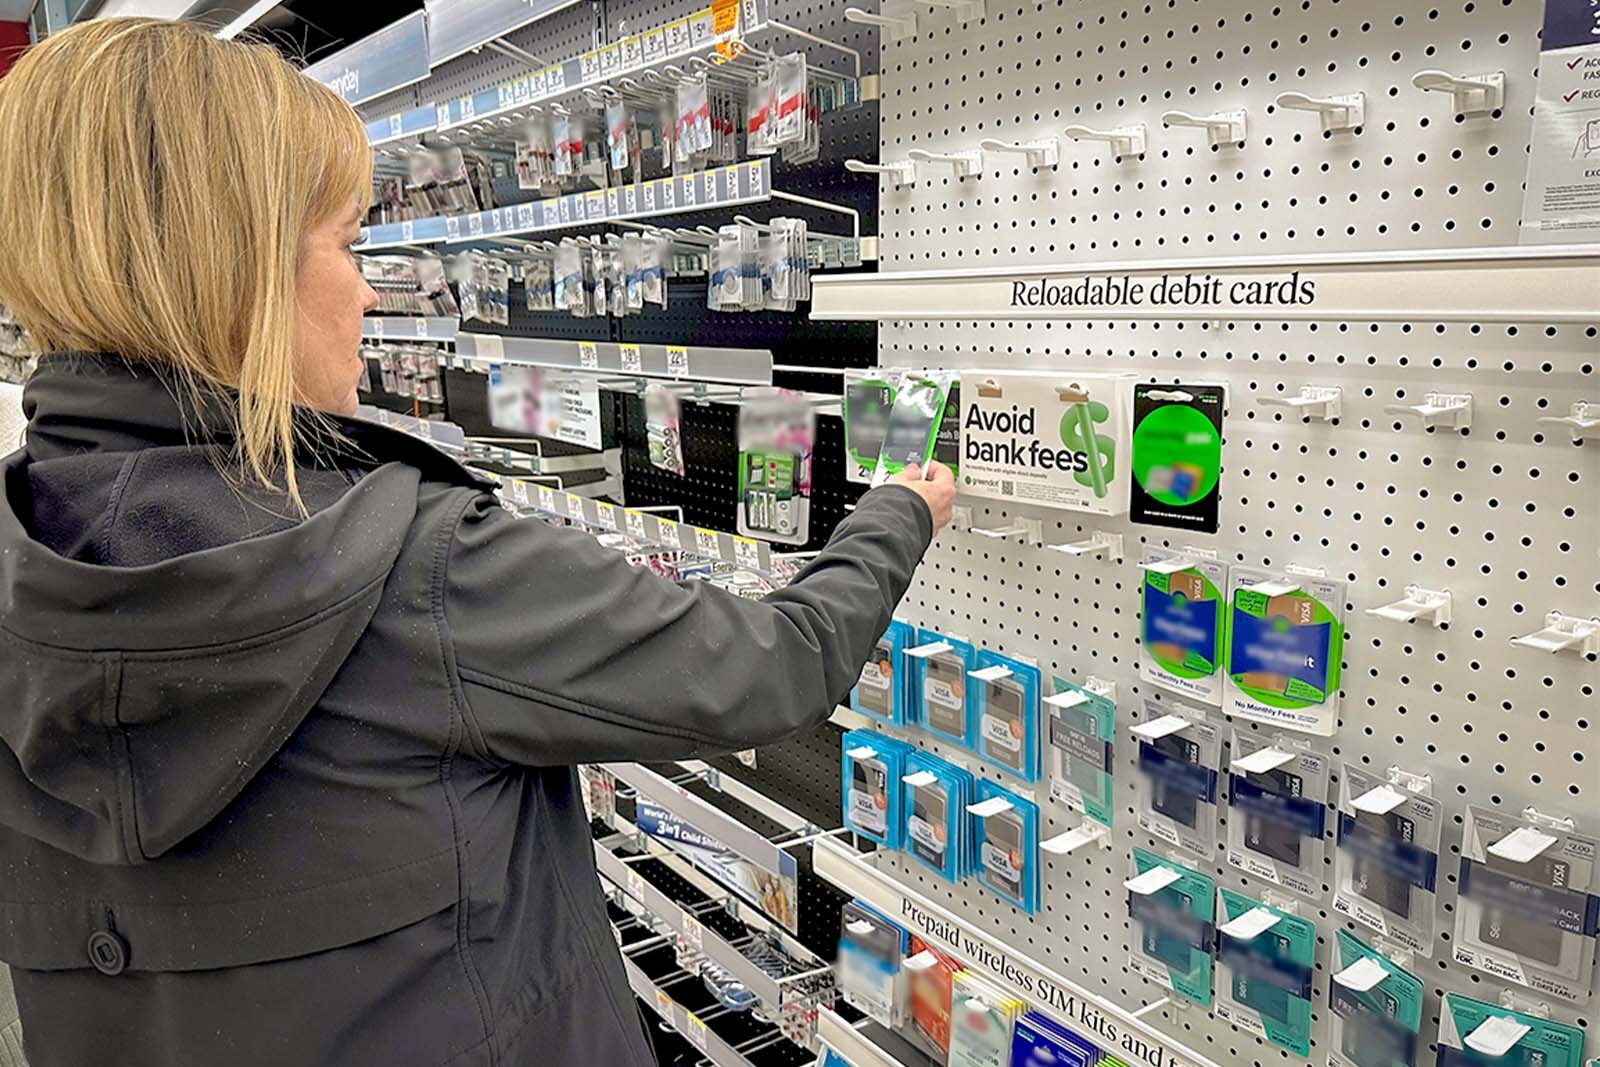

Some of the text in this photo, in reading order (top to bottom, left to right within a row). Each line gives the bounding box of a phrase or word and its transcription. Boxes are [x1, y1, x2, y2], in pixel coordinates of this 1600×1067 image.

[1010, 271, 1315, 306] Reloadable debit cards
[965, 403, 1035, 435] Avoid
[966, 433, 1089, 473] bank fees
[1193, 579, 1203, 600] VISA
[1300, 601, 1312, 624] VISA
[864, 668, 879, 679] VISA
[1157, 670, 1180, 685] Monthly
[1179, 679, 1195, 689] Fees
[934, 686, 951, 699] VISA
[1234, 700, 1246, 708] No
[1246, 703, 1277, 716] Monthly
[1277, 709, 1296, 720] Fees
[992, 723, 1009, 739] VISA
[857, 798, 873, 810] VISA
[681, 831, 701, 844] Child
[1402, 821, 1414, 843] VISA
[991, 852, 1009, 869] VISA
[1552, 863, 1566, 889] VISA
[1557, 907, 1581, 921] ACK
[901, 898, 960, 948] Prepaid
[963, 938, 1033, 992] wireless
[1036, 978, 1075, 1018] SIM
[1079, 1002, 1117, 1042] kits
[1121, 1033, 1163, 1067] and
[1502, 970, 1521, 981] BACK
[1554, 989, 1576, 999] EARLY
